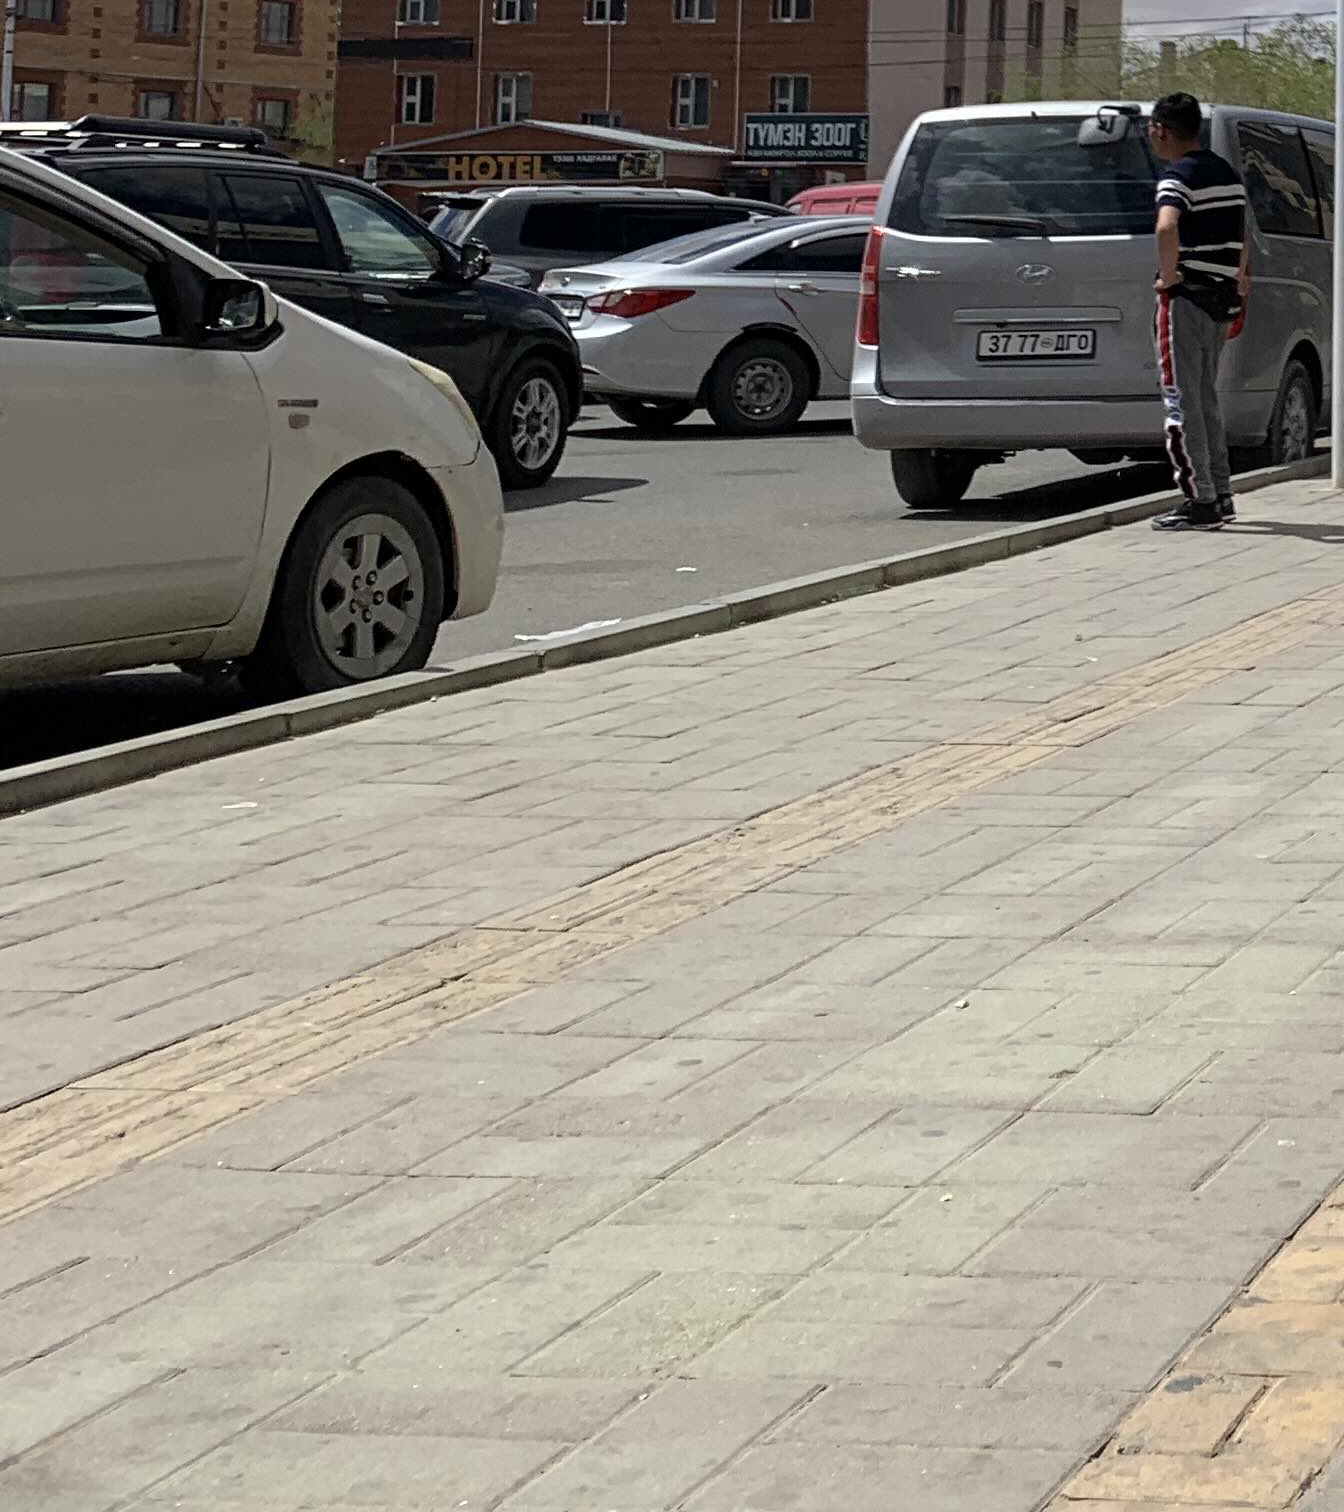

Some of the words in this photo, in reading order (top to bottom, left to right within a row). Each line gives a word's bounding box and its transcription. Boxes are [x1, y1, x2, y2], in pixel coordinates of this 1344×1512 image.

[810, 123, 857, 147] ЗООГ
[448, 156, 547, 181] HOTEL
[1053, 334, 1089, 352] ДГО
